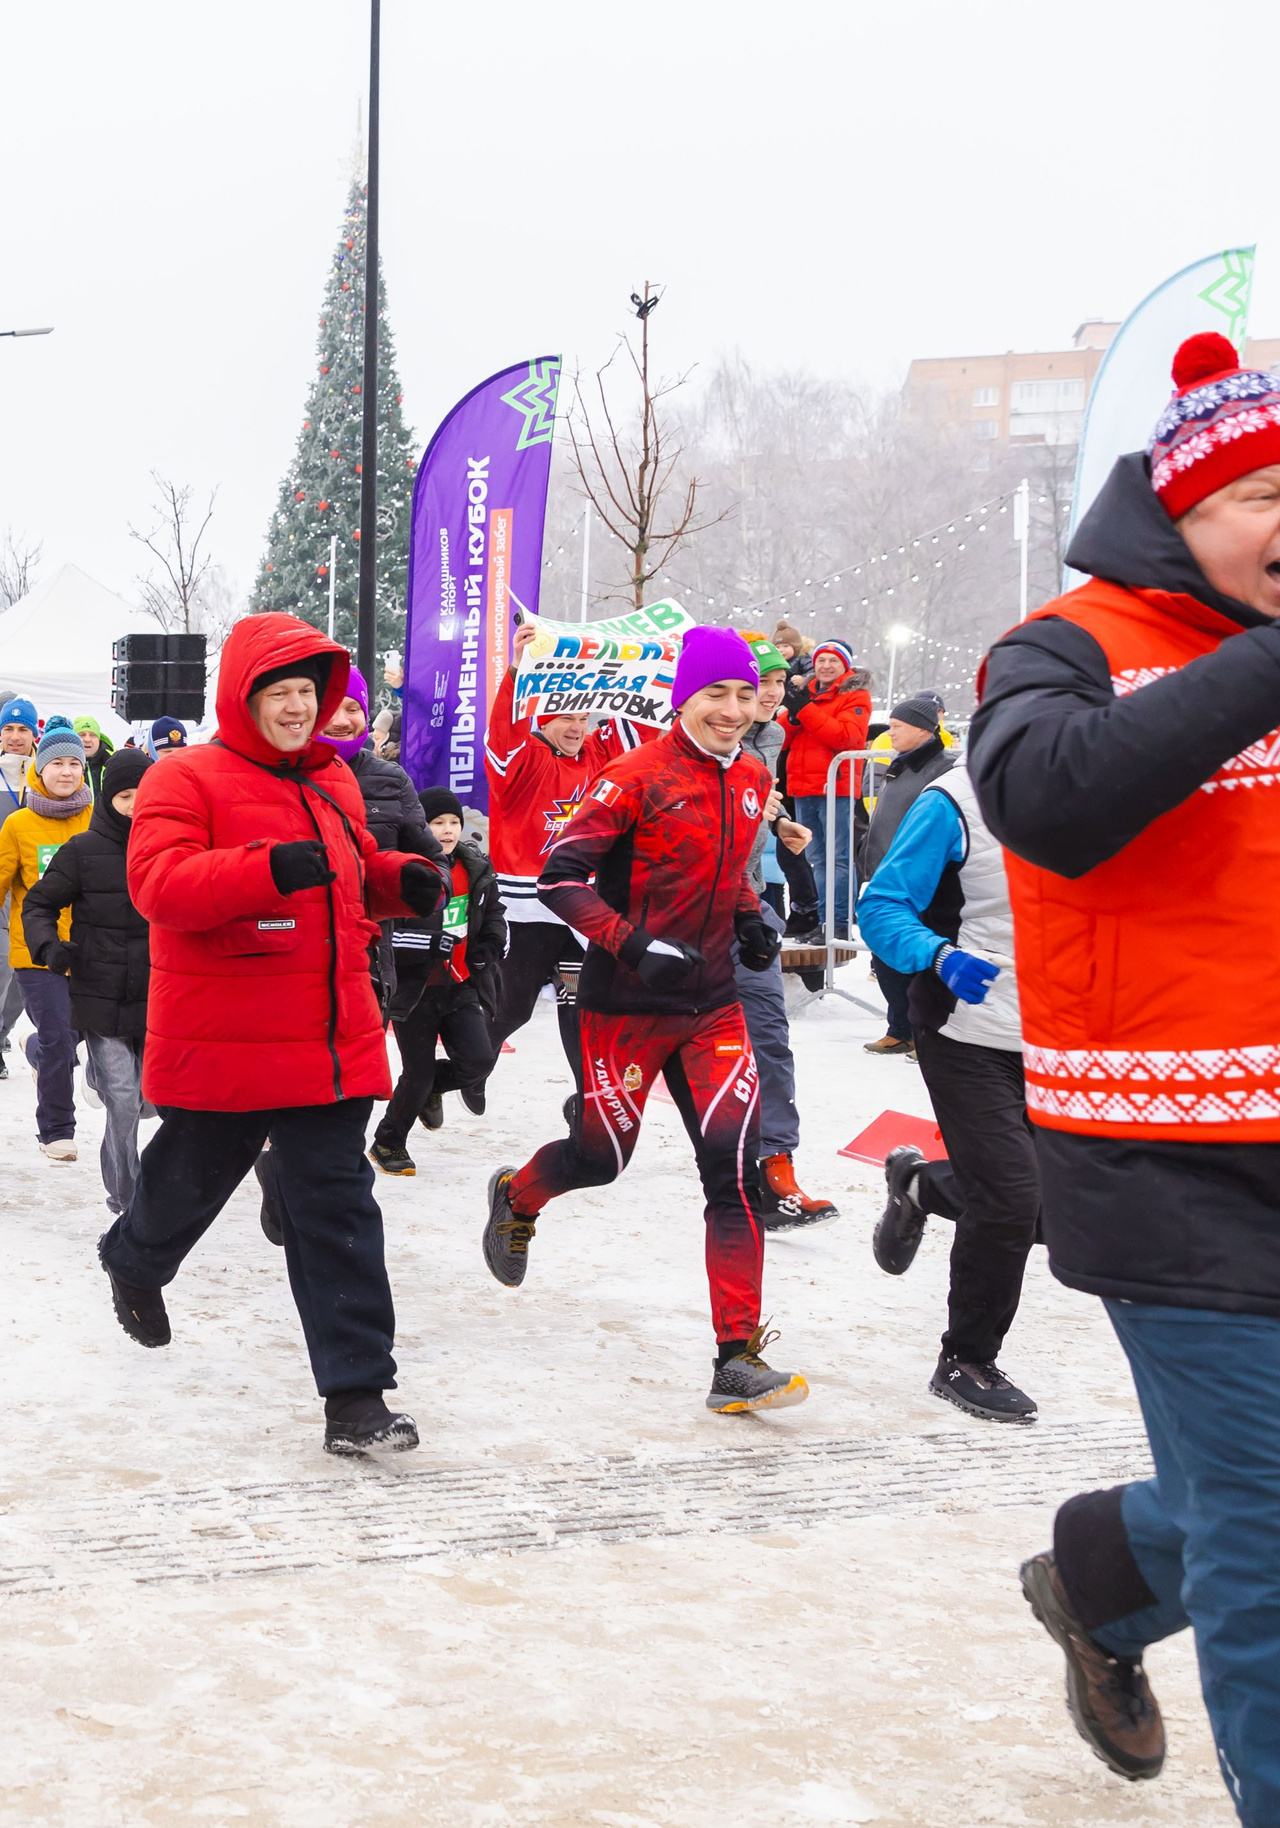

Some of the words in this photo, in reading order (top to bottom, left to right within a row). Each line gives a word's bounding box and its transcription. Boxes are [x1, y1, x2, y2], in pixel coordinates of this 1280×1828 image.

[494, 515, 507, 552] забег
[440, 528, 450, 616] КАЛАШНИКОВ
[448, 575, 457, 616] СПОРТ
[493, 555, 505, 651] многодневный
[449, 575, 483, 794] ПЕЛЬМЕННЫЙ
[467, 455, 490, 565] КУБОК
[516, 672, 648, 700] ИЖЕВСКАЯ
[595, 1058, 634, 1133] УДМУРТИЯ
